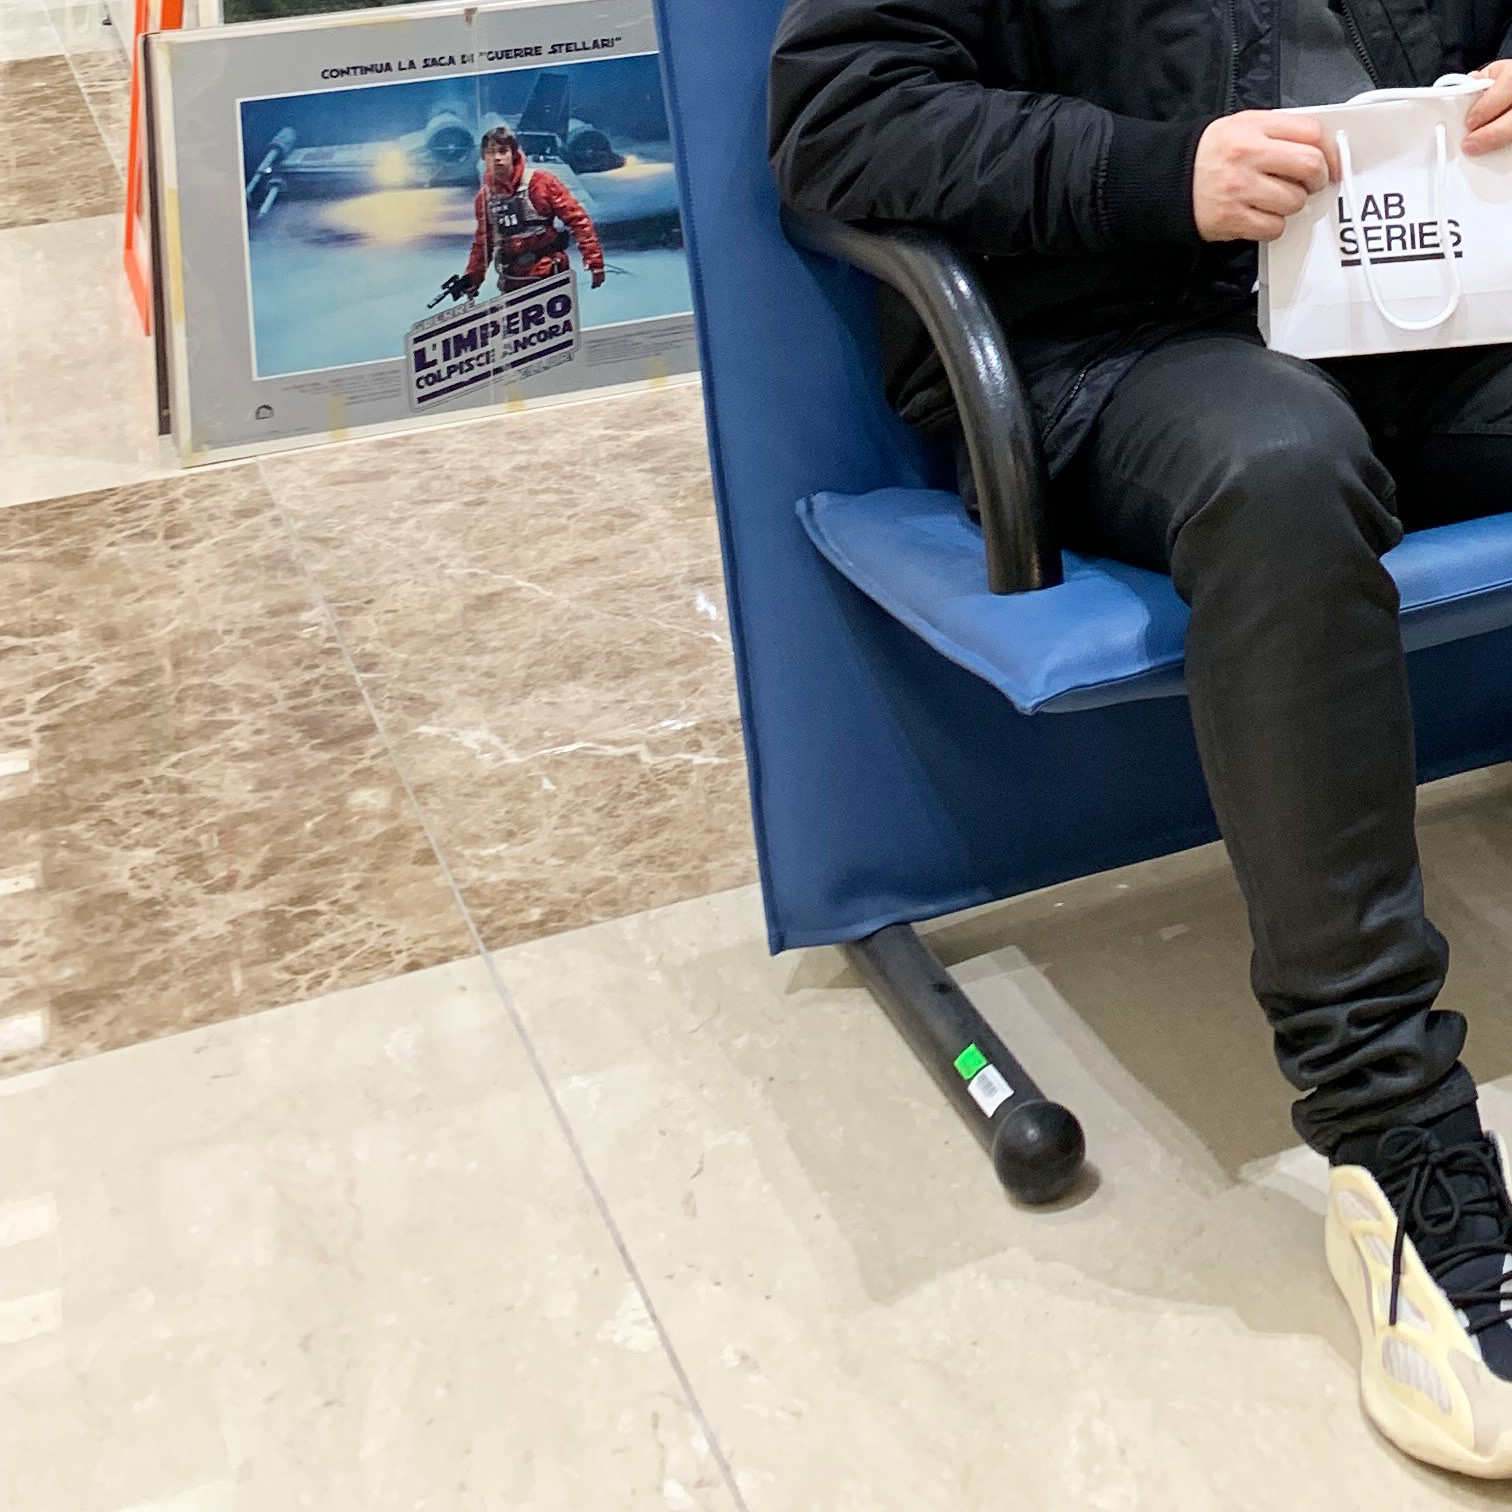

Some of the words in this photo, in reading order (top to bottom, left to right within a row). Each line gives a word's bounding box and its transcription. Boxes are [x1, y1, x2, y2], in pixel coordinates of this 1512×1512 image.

[320, 61, 393, 80] CONTINUA
[398, 59, 417, 72] LA
[1337, 192, 1406, 224] LAB
[413, 293, 573, 373] L'IMPERO
